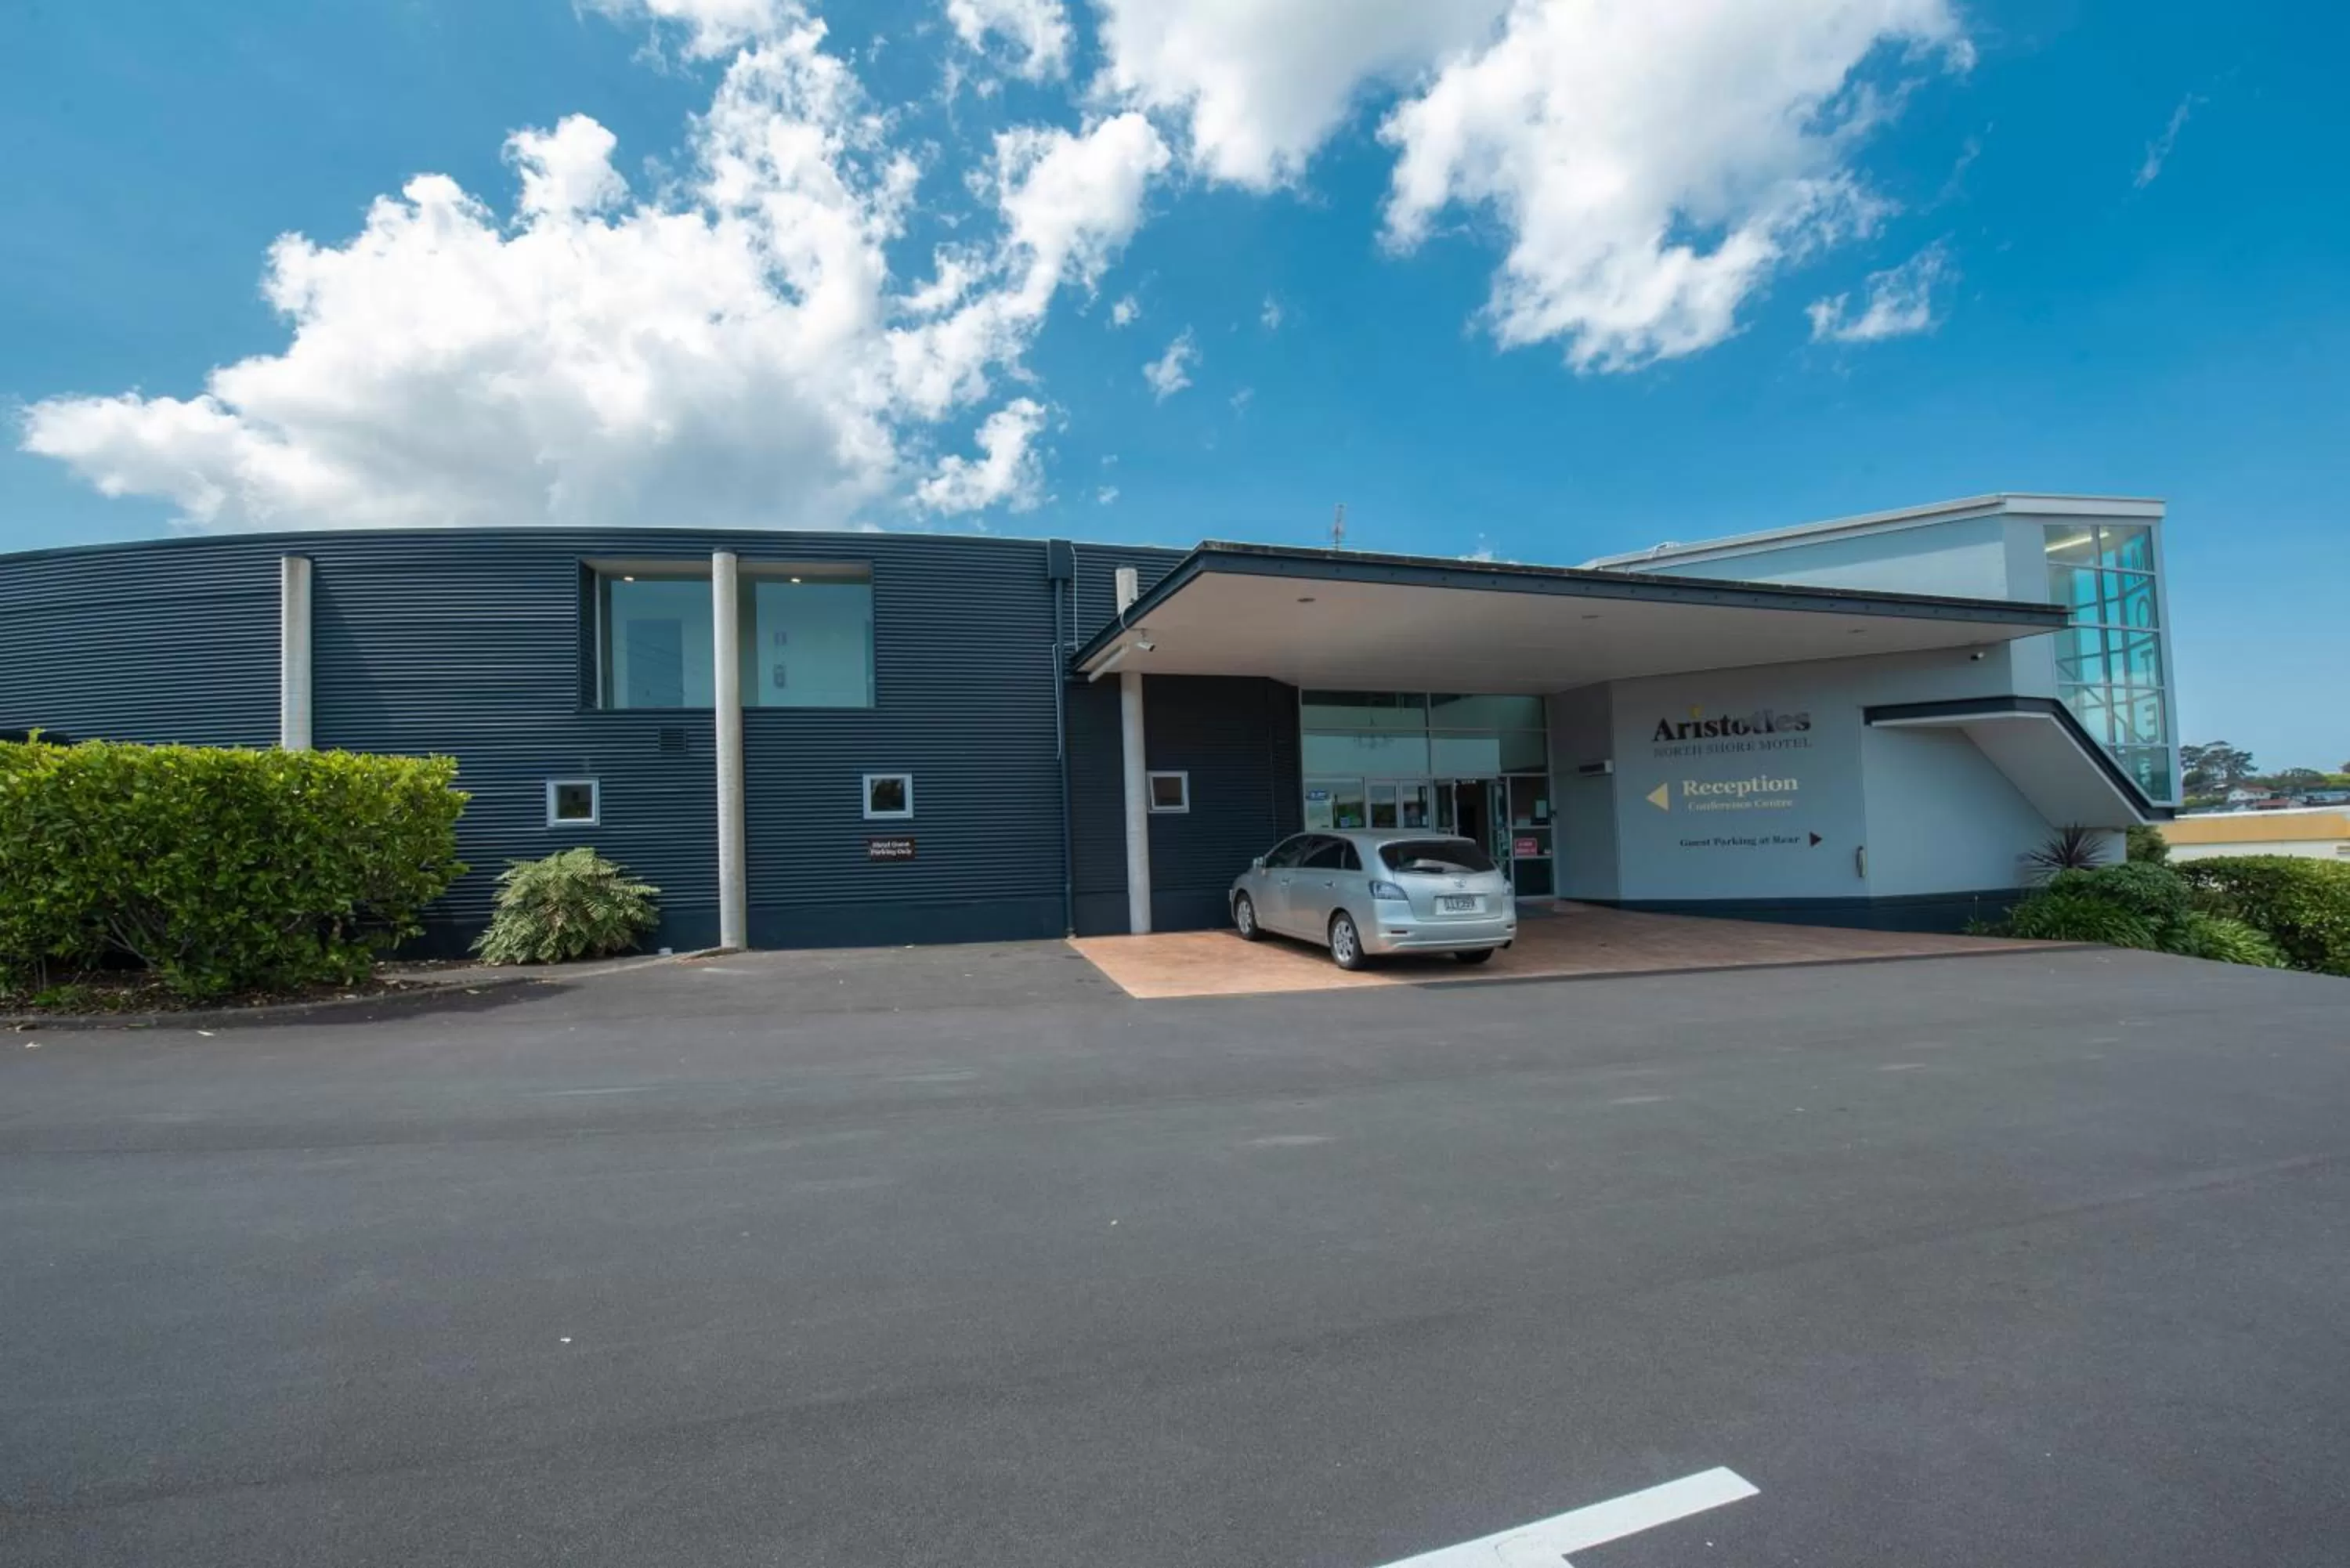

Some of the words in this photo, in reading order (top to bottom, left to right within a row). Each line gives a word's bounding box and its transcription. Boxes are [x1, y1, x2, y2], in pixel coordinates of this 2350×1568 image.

[1652, 704, 1811, 742] Aristotles
[1654, 743, 1701, 757] NORTH
[1705, 741, 1755, 754] SHORE
[1759, 738, 1812, 750] MOTEL
[1682, 775, 1799, 797] Reception
[1687, 800, 1752, 811] Conference
[1755, 799, 1792, 809] Centre
[1679, 838, 1710, 847] Guest
[1714, 837, 1756, 847] Parking
[1773, 836, 1801, 844] Rear
